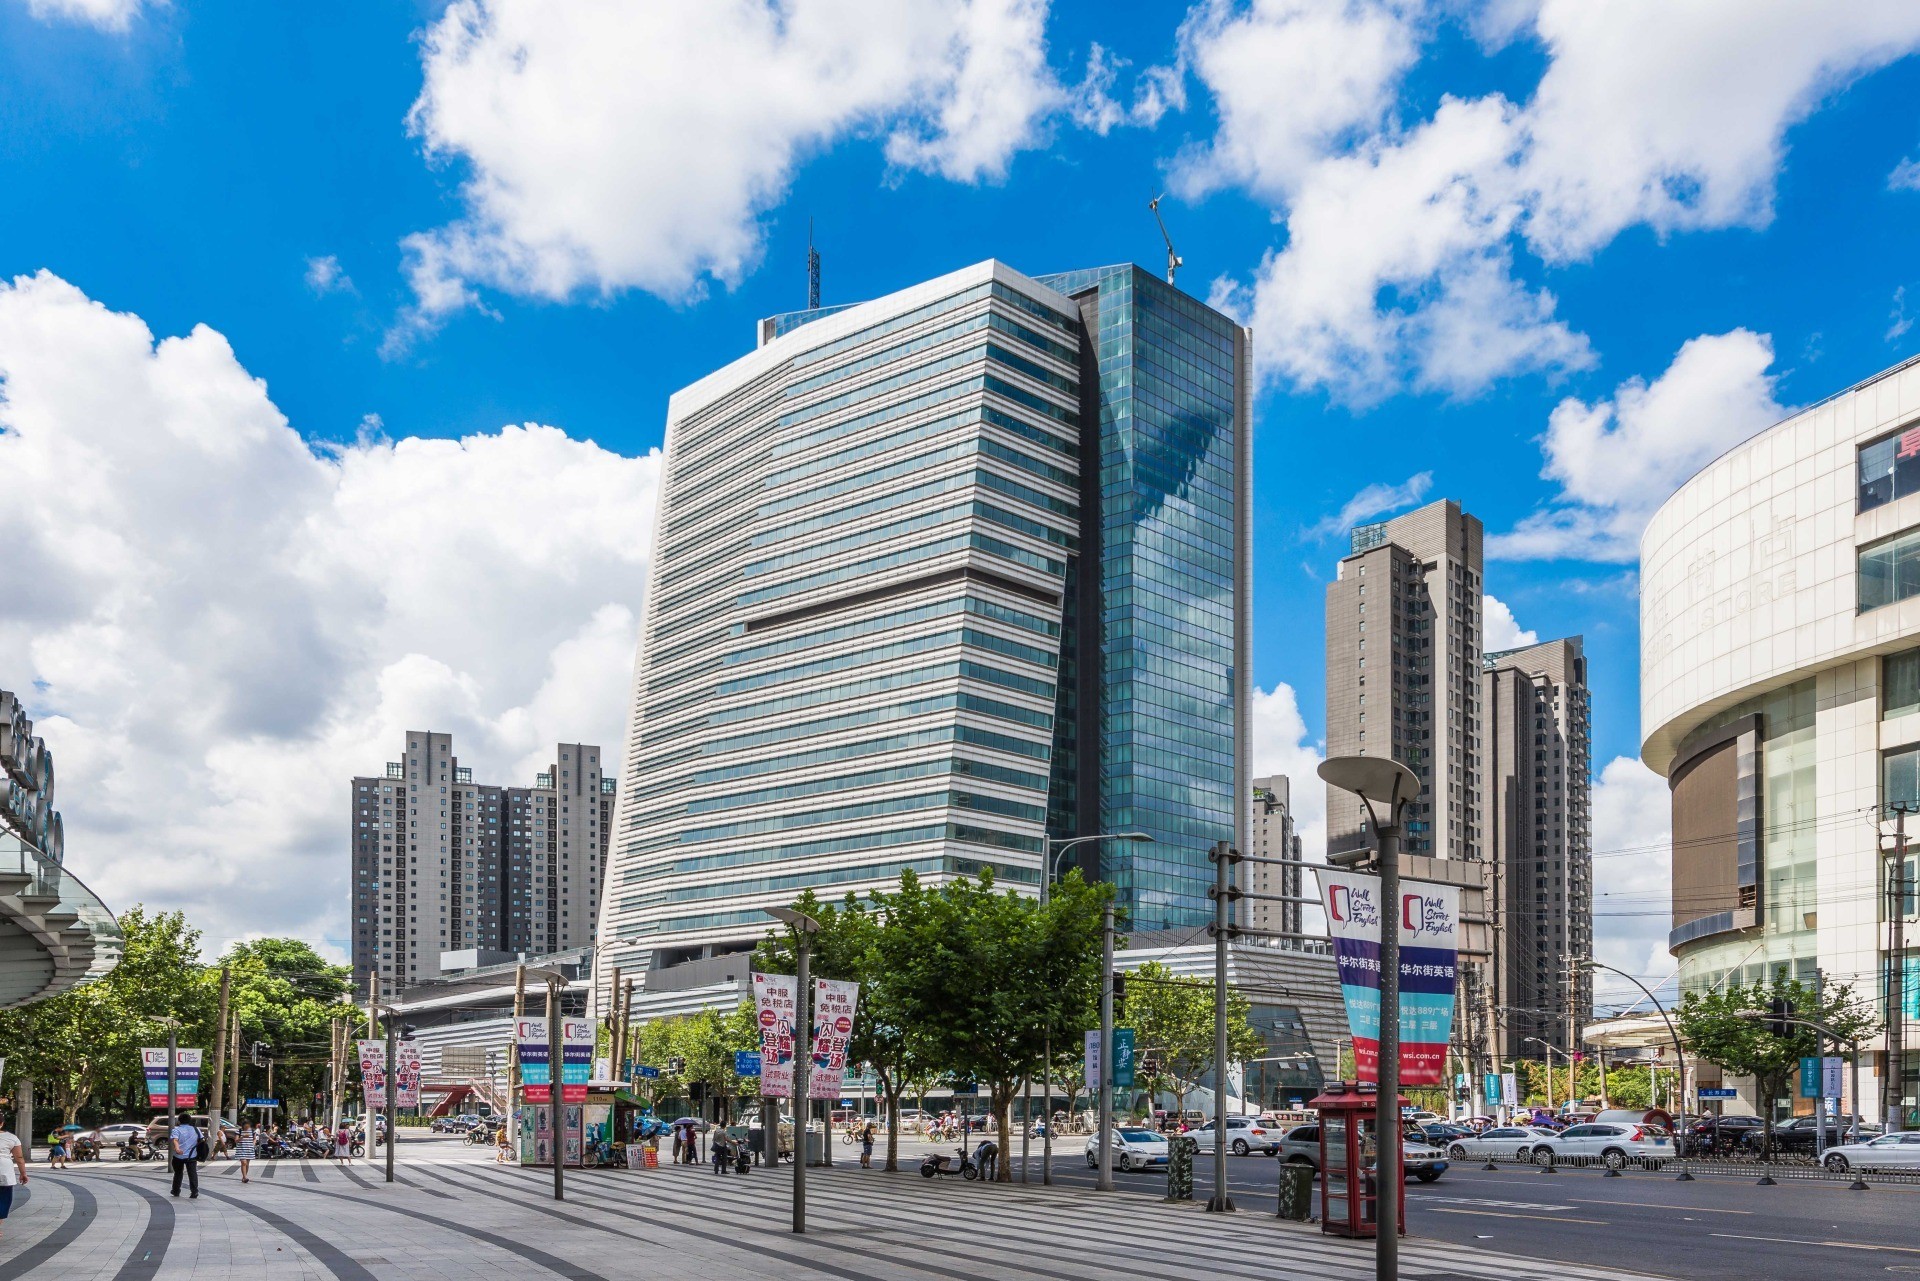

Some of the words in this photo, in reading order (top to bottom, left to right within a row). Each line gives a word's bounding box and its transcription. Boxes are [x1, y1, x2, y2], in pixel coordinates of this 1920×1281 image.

[1351, 888, 1370, 901] Wall
[1352, 900, 1376, 913] Street
[1424, 897, 1444, 909] Wall
[1352, 912, 1379, 927] English
[1425, 909, 1450, 921] Street
[1425, 921, 1453, 936] English
[1400, 964, 1454, 978] 华尔街英语
[767, 987, 788, 998] 中服
[826, 994, 847, 1003] 中服
[761, 997, 793, 1009] 免税店
[820, 1003, 852, 1014] 免税店
[1401, 1005, 1449, 1017] 悦达889广场
[1403, 1052, 1440, 1060] wsi.com.cn
[765, 1070, 789, 1080] 试营业
[816, 1073, 839, 1083] 试营业
